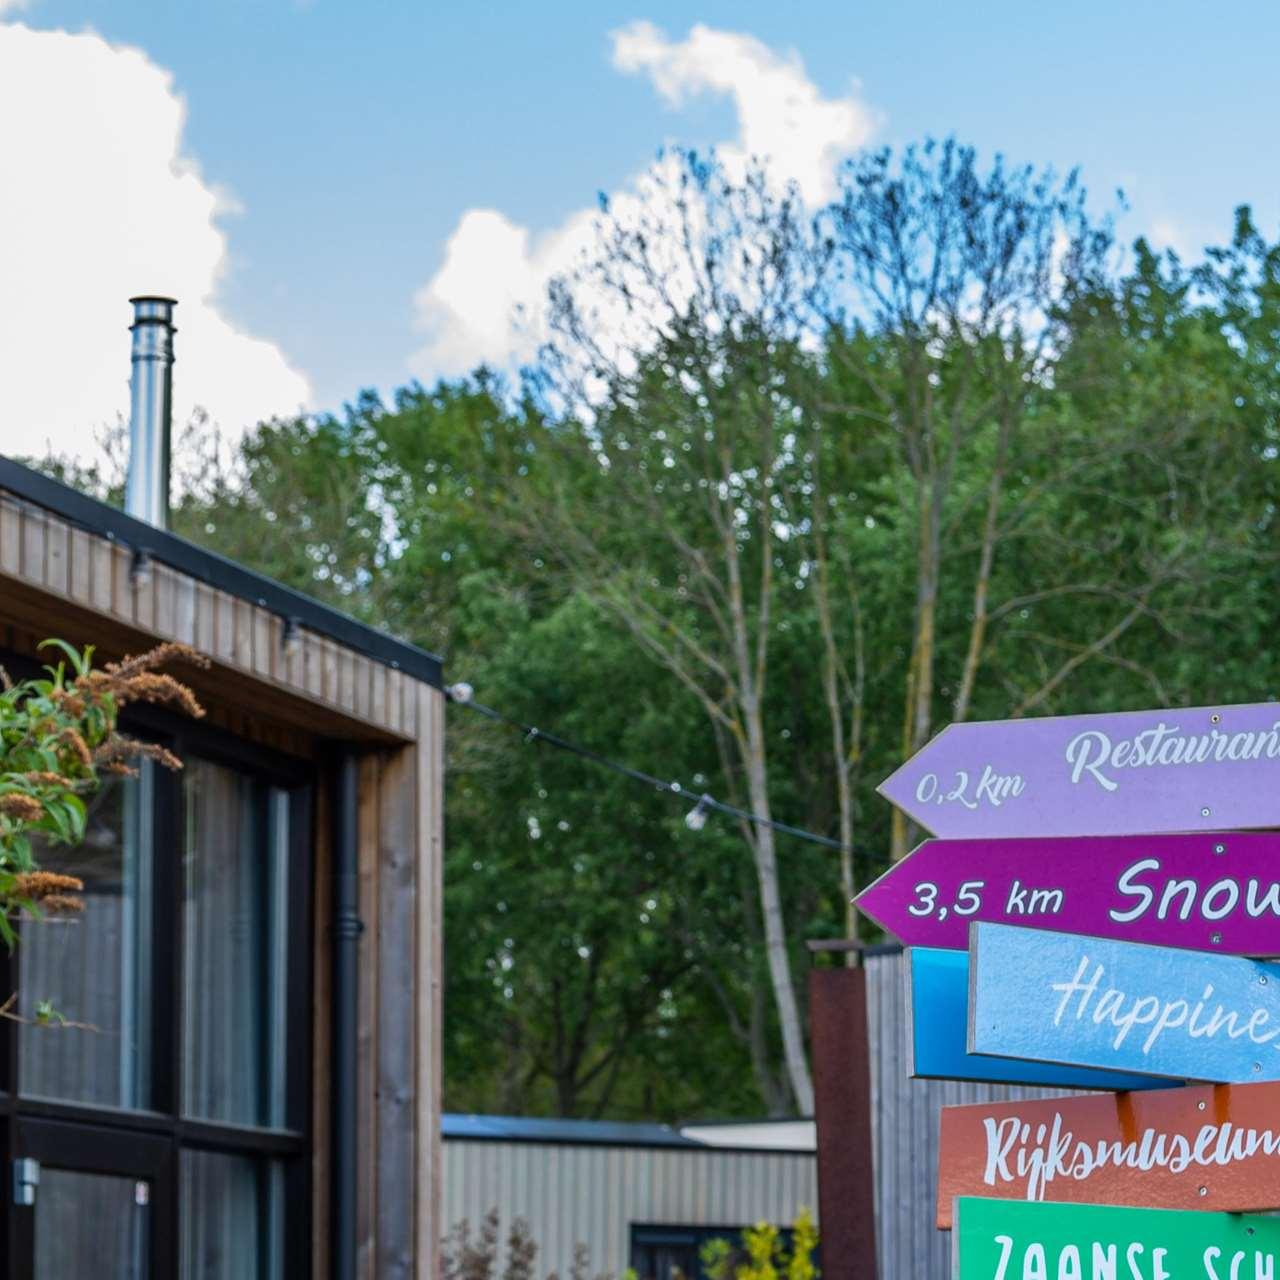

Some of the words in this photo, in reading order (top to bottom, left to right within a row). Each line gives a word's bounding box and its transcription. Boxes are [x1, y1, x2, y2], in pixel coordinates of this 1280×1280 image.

[915, 771, 978, 809] 0,2
[975, 764, 1025, 807] km
[908, 881, 985, 918] 3,5
[1006, 881, 1064, 915] km
